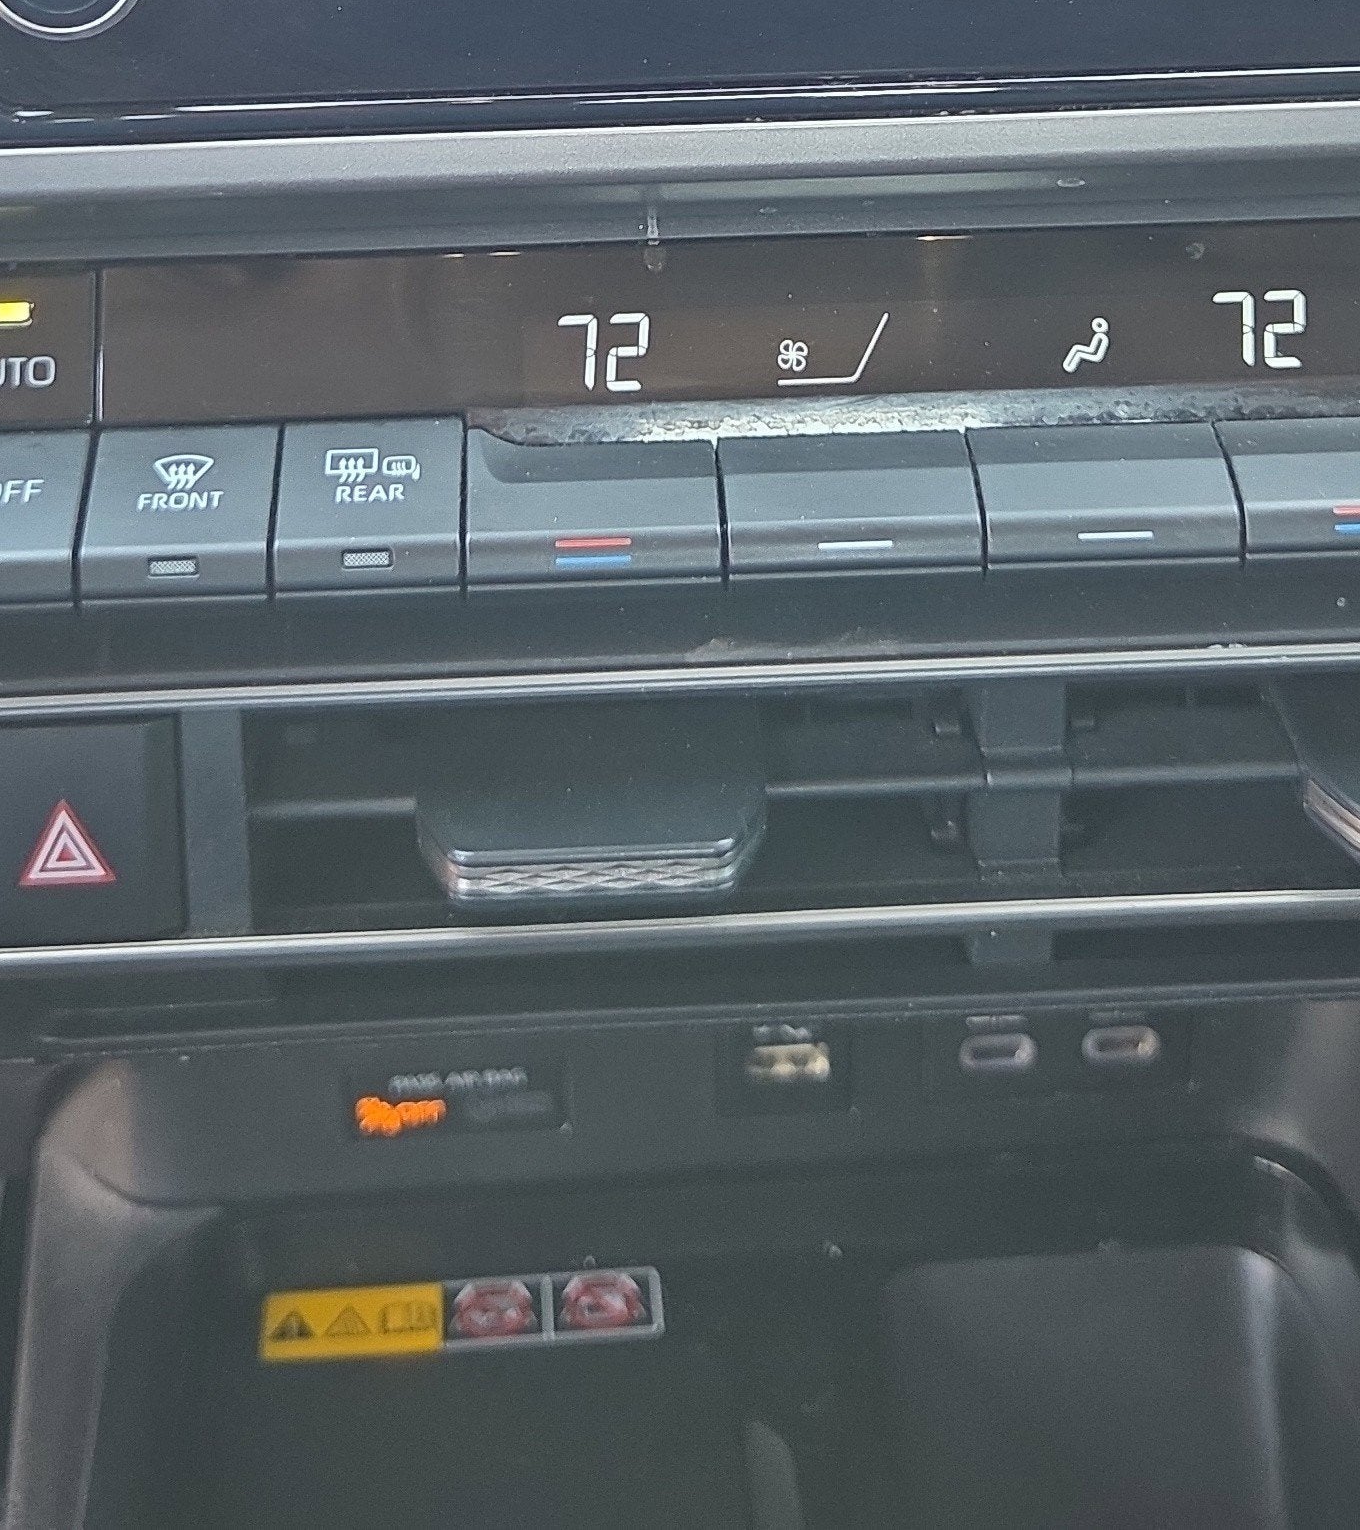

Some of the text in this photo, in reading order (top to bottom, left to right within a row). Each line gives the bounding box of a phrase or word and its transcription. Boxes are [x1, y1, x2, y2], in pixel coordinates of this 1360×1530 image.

[558, 312, 650, 392] 72
[1212, 289, 1306, 368] 72
[137, 489, 223, 511] FRONT
[335, 482, 405, 504] REAR
